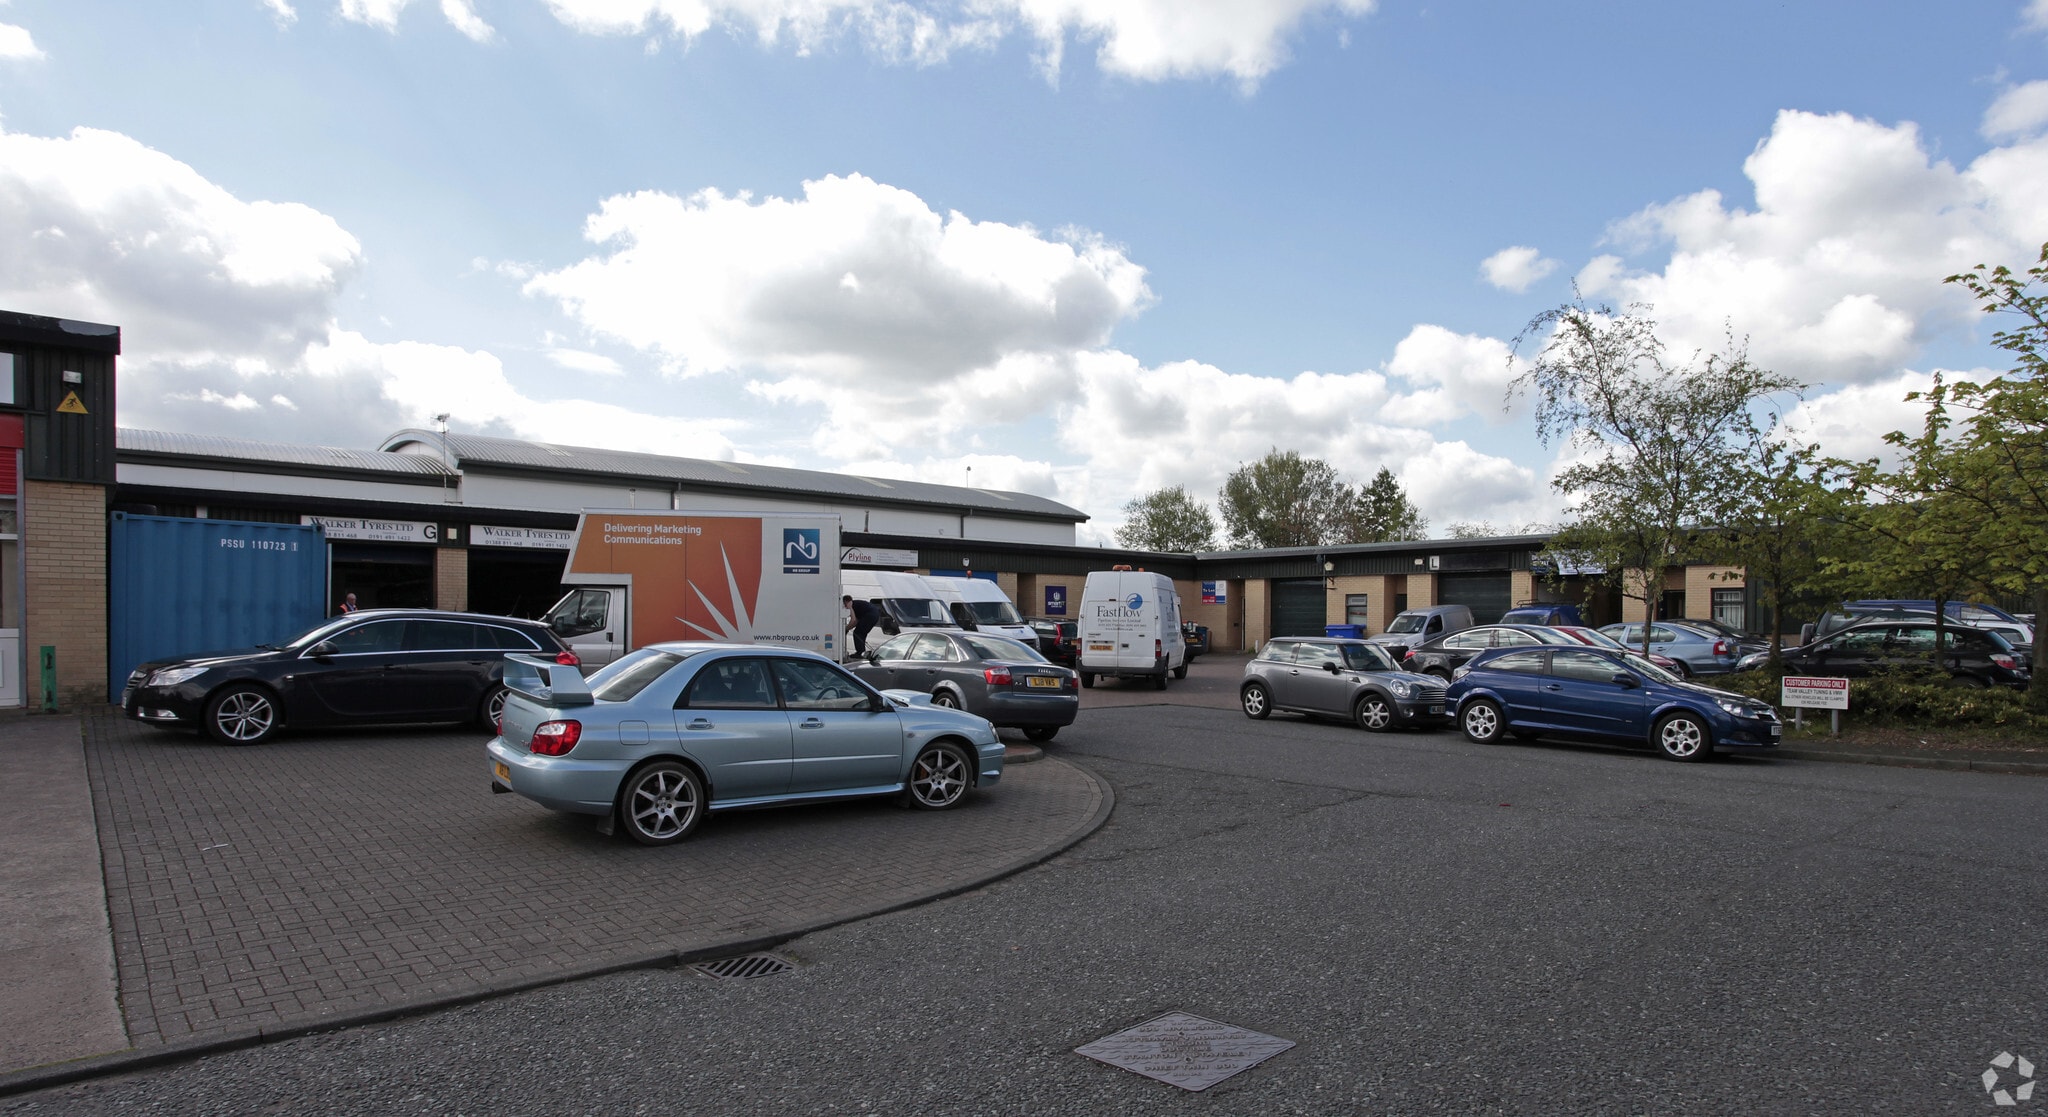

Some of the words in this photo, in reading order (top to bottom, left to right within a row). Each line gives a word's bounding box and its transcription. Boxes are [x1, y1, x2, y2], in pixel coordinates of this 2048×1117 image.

[360, 519, 393, 530] TYRES
[396, 523, 414, 532] LTD
[605, 523, 652, 535] Delivering
[655, 524, 702, 536] Marketing
[423, 525, 437, 539] G
[482, 526, 522, 537] WALKER
[524, 528, 553, 539] TYRES
[555, 532, 571, 540] LTD
[220, 539, 245, 549] PSSU
[251, 540, 286, 550] 110723
[604, 534, 682, 545] Communications
[848, 553, 872, 562] Plyline
[1432, 558, 1438, 568] L
[1097, 606, 1142, 617] Fastflow
[754, 634, 819, 642] www.nbgroup.co.uk
[1785, 679, 1810, 687] CUSTOMER
[1811, 680, 1831, 688] PARKING
[1832, 680, 1844, 688] ONLY
